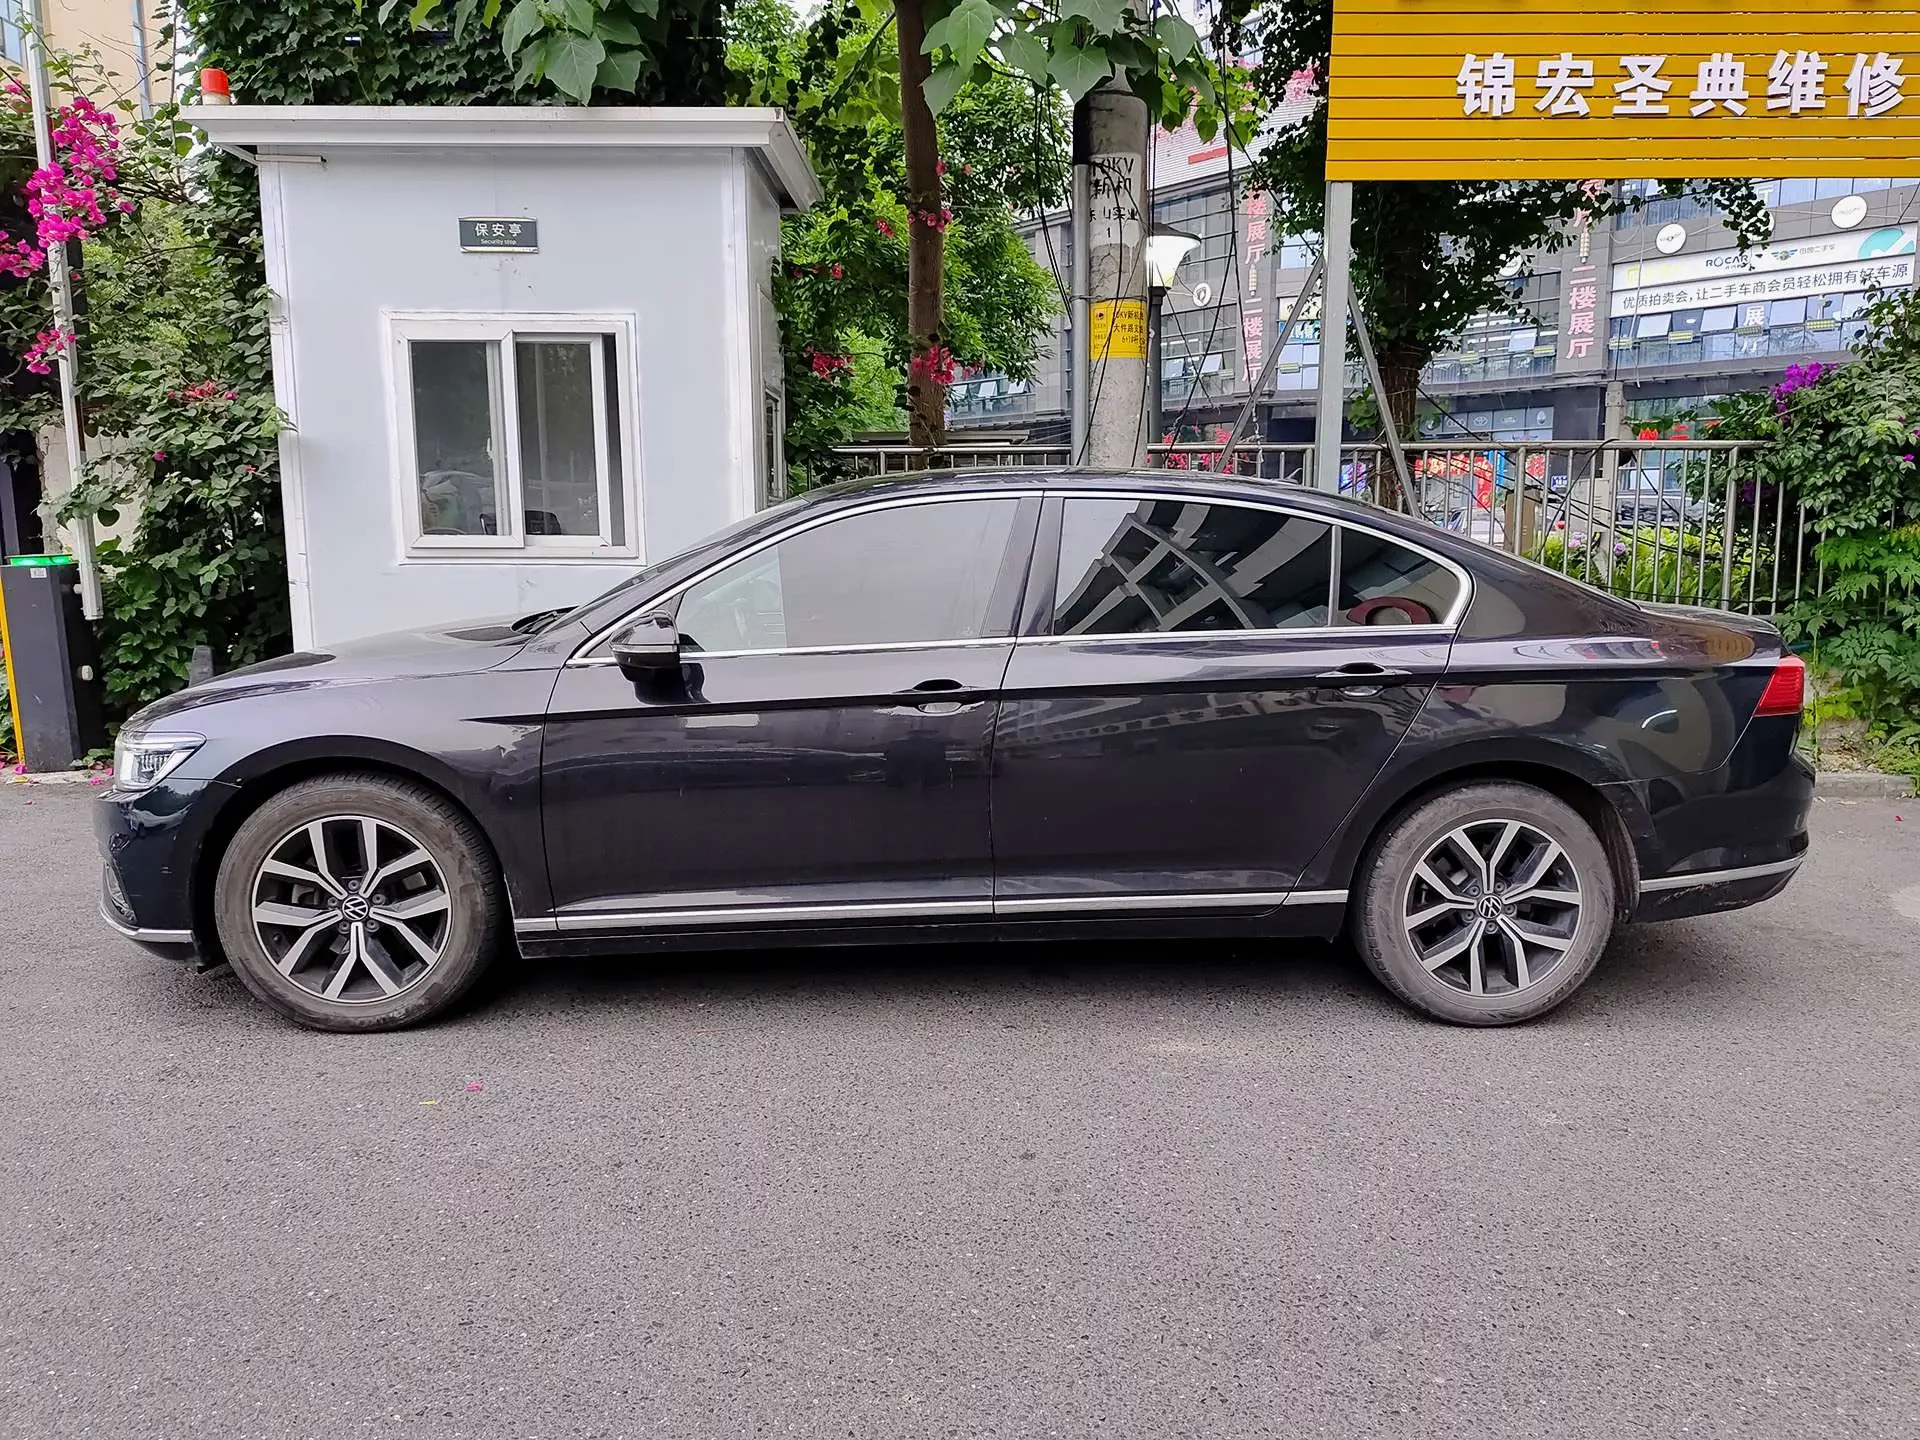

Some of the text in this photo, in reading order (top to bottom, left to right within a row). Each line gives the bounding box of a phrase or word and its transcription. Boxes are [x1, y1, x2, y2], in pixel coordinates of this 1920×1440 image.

[1456, 48, 1906, 118] 锦宏圣典维修
[475, 223, 522, 237] 保安亭
[1705, 254, 1749, 267] ROCAR
[1242, 297, 1263, 381] 二楼展厅
[1566, 264, 1597, 359] 二楼展厅
